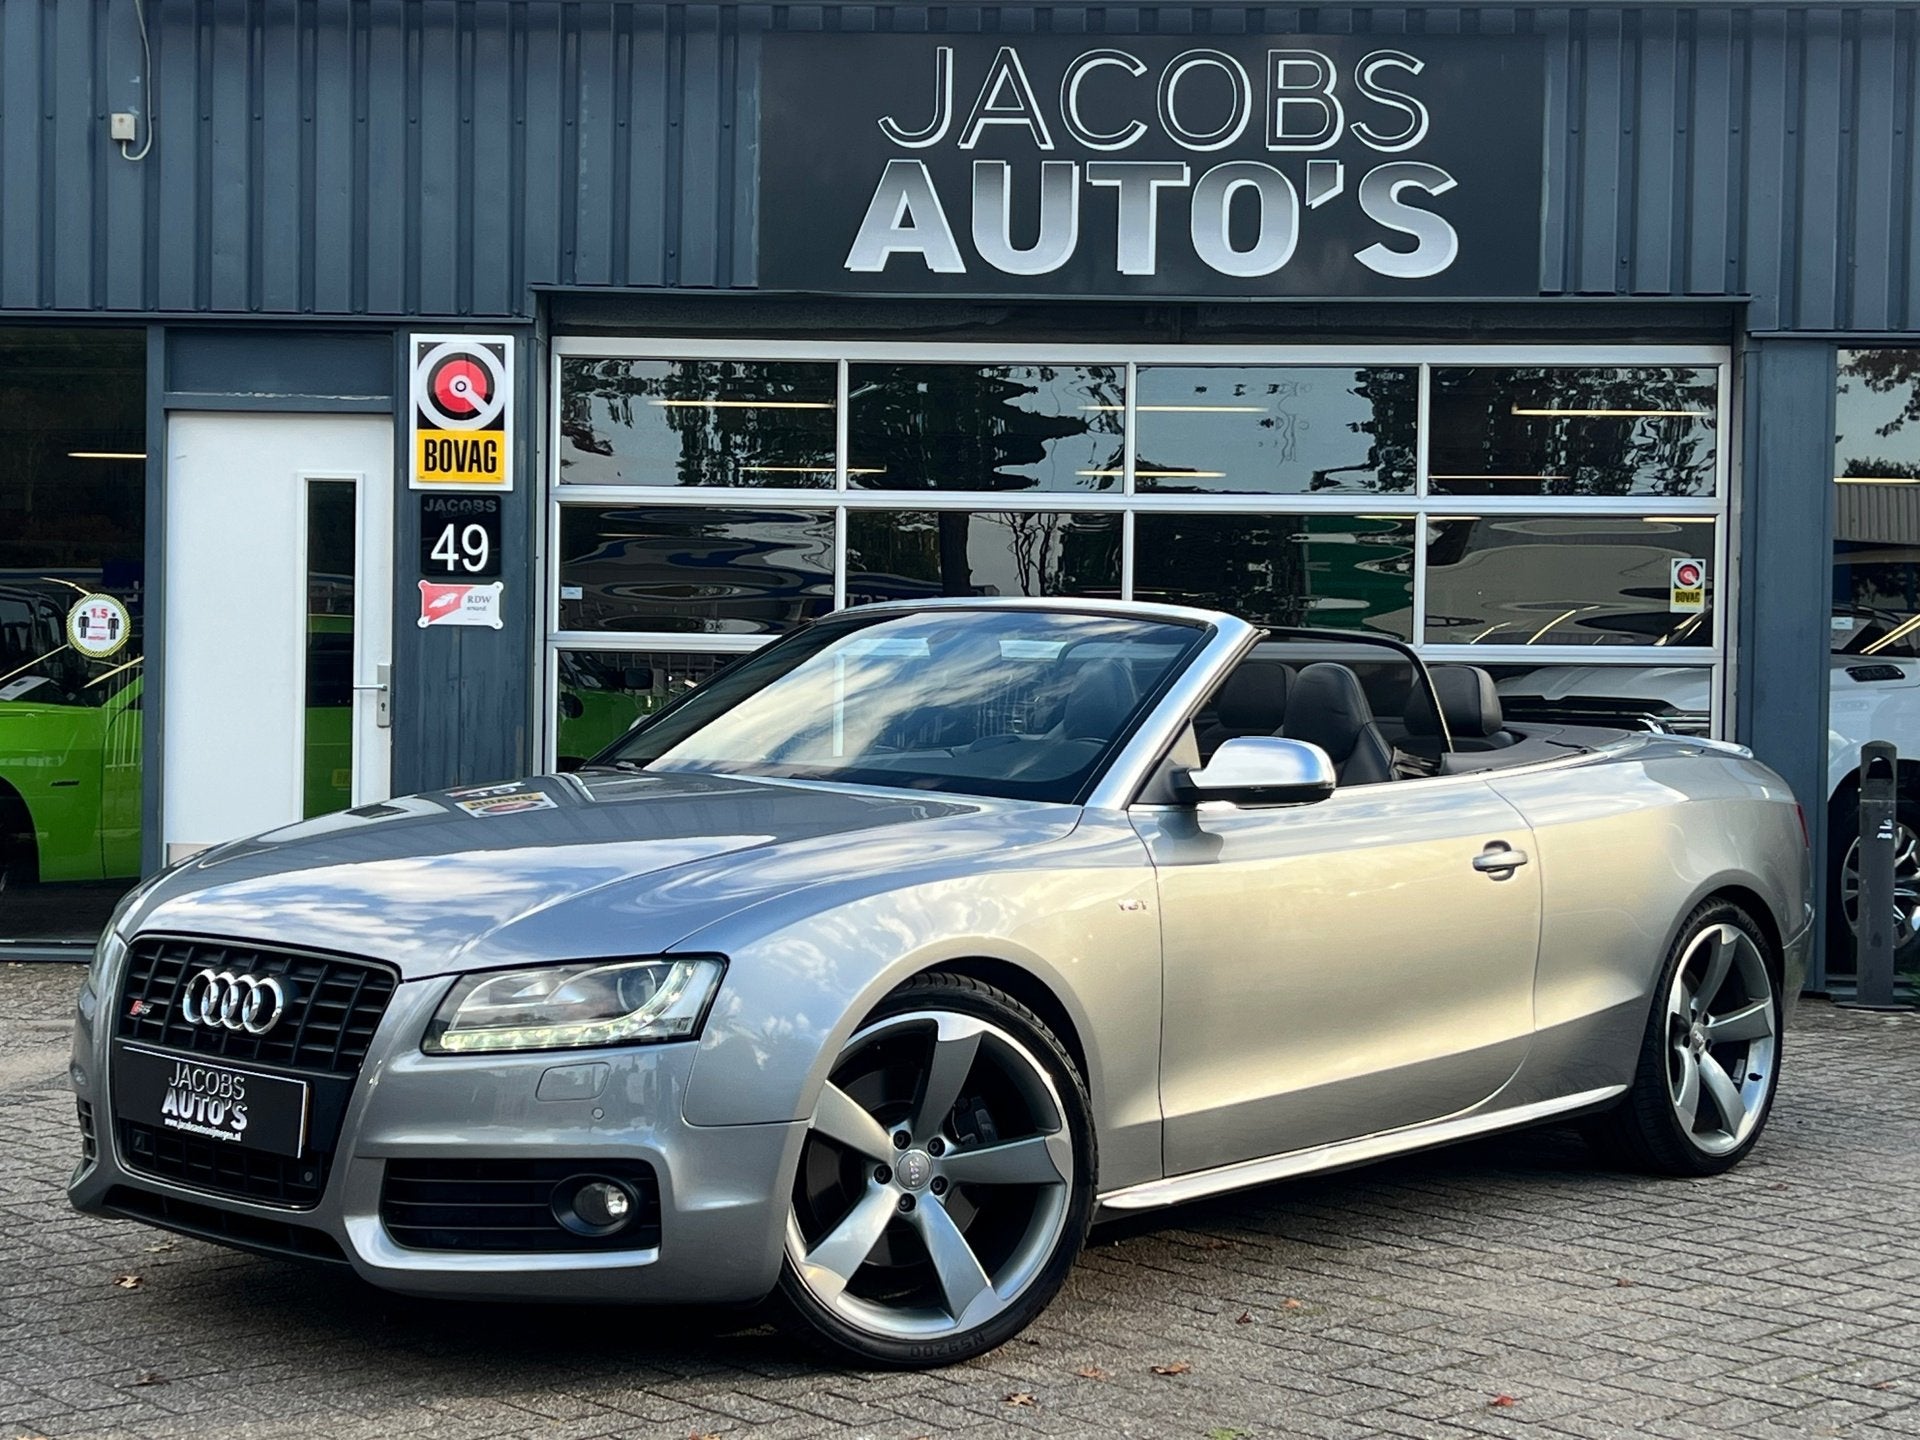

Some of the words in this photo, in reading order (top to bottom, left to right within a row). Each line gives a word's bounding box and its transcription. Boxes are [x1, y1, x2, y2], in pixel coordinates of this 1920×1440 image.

[877, 46, 1430, 152] JACOBS
[843, 159, 1459, 278] AUTO'S
[424, 438, 497, 474] BOVAG
[424, 499, 497, 513] JACOBS
[430, 523, 489, 573] 49
[467, 595, 491, 604] RDW
[168, 1061, 245, 1100] JACOBS
[161, 1087, 248, 1131] AUTO'S
